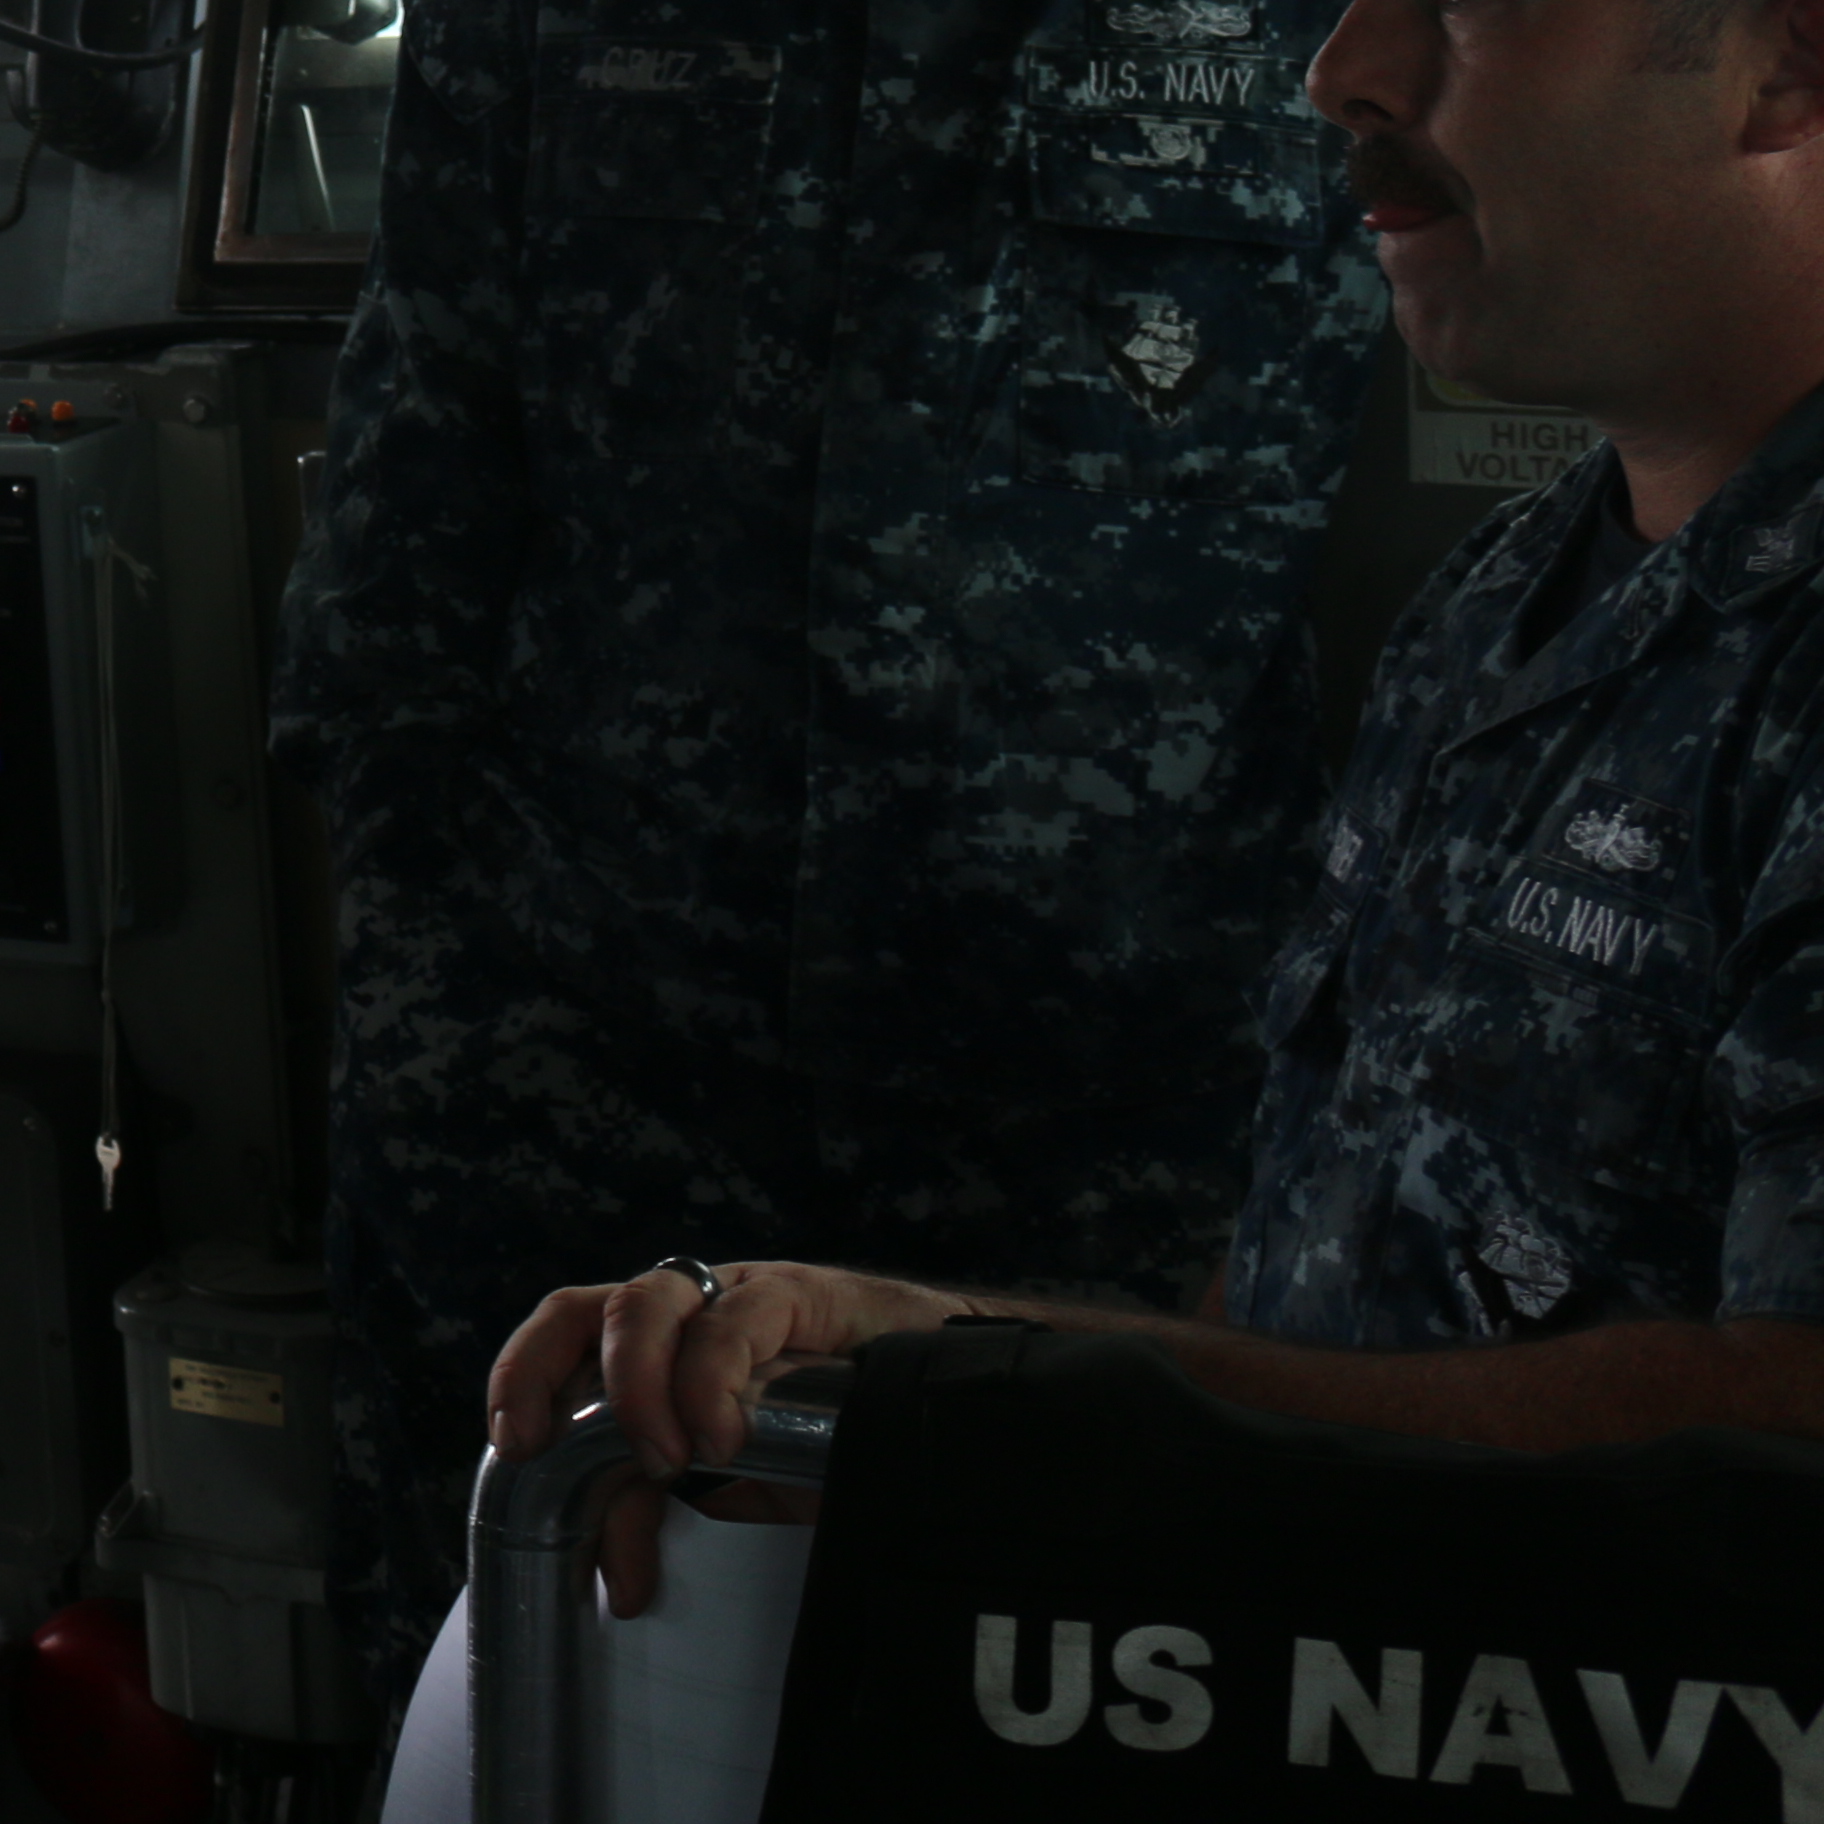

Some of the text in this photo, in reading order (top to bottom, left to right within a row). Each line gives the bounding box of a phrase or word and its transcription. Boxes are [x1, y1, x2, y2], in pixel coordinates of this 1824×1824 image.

[1088, 60, 1256, 107] U.S. NAVY
[1491, 421, 1589, 452] HIGH
[1507, 877, 1657, 976] U.S. NAVY
[973, 1613, 1824, 1824] US NAVY
